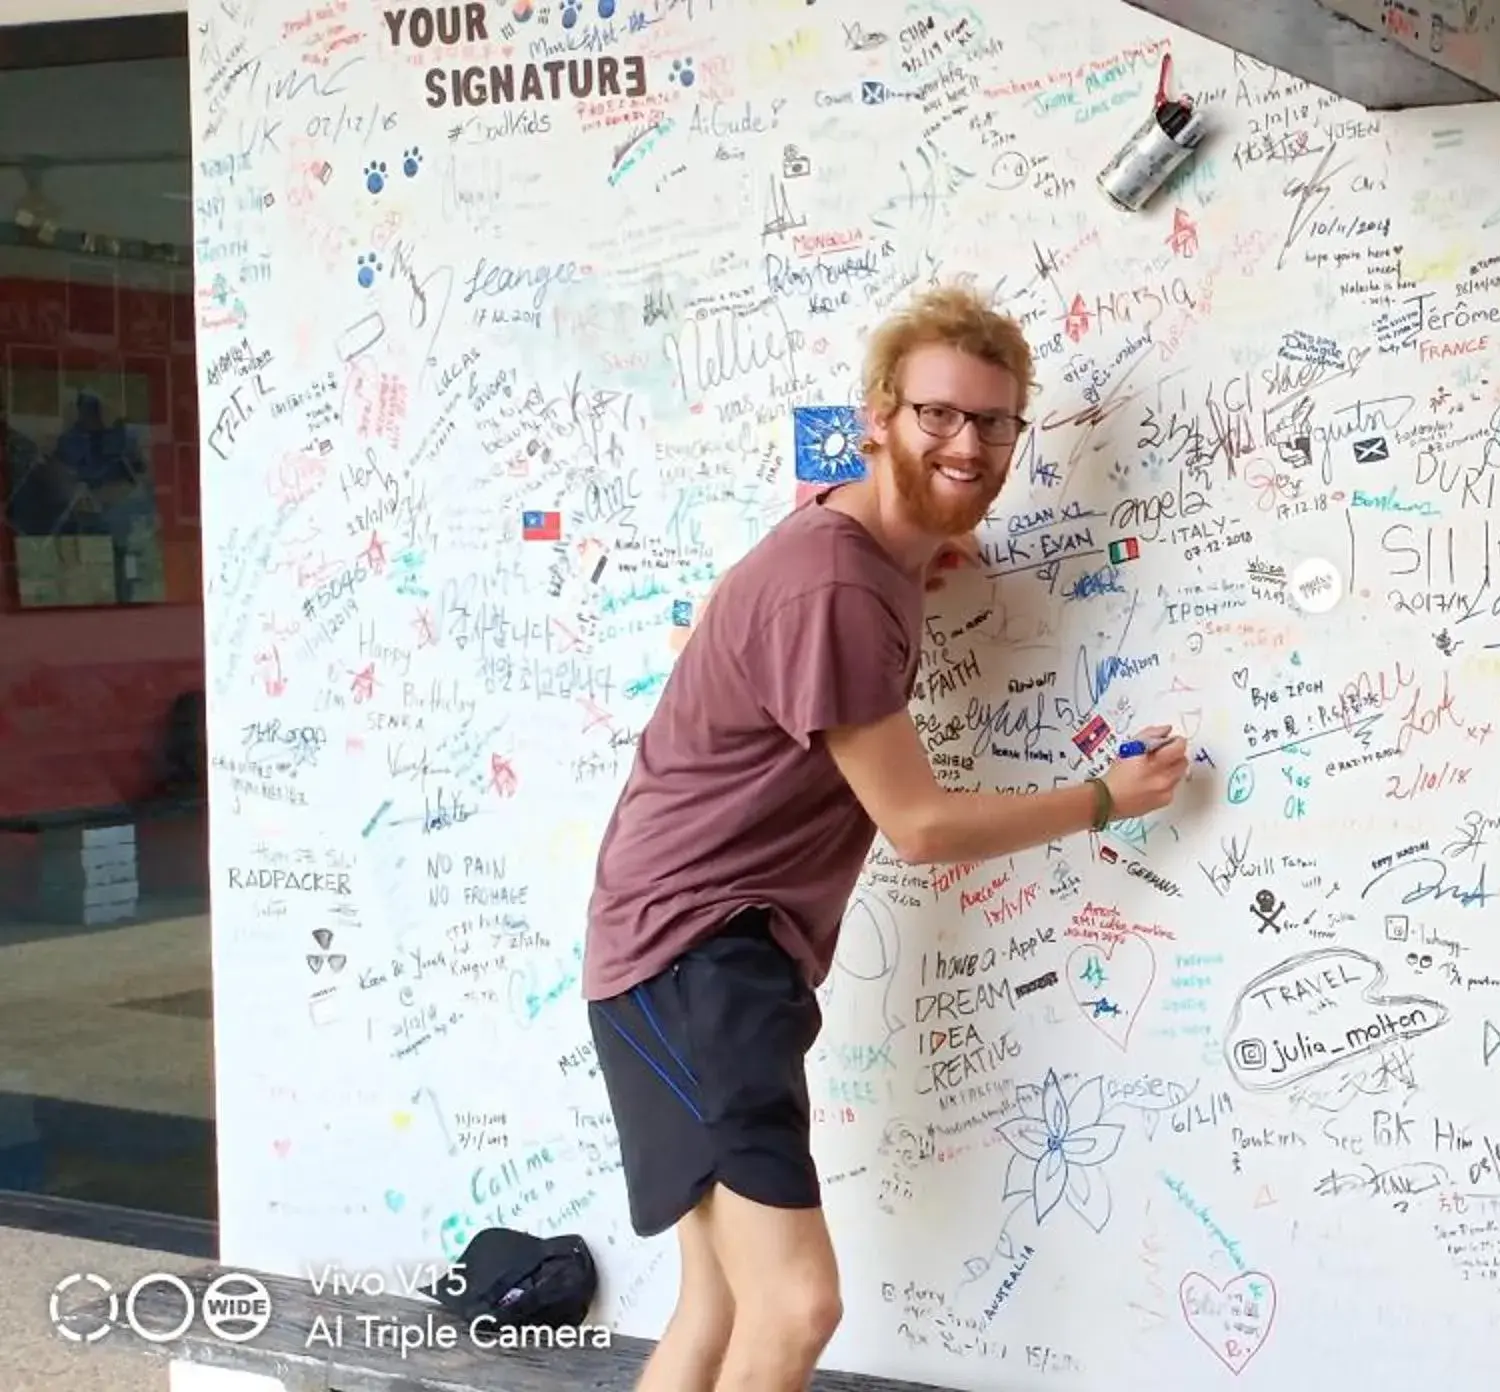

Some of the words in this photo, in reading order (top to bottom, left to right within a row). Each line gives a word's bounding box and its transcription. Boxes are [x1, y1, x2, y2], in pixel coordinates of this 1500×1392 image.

[383, 1, 489, 48] YOUR
[1418, 335, 1490, 364] FRANCE
[927, 648, 982, 705] FAITH
[426, 855, 455, 880] NO
[463, 854, 507, 880] PAIN
[427, 885, 451, 907] NO
[935, 951, 977, 980] have
[914, 977, 1017, 1024] DREAM
[1251, 963, 1362, 1014] TRAVEL
[918, 1023, 984, 1056] IDEA
[525, 1150, 558, 1176] me
[983, 1243, 1037, 1323] AUSTRALIA
